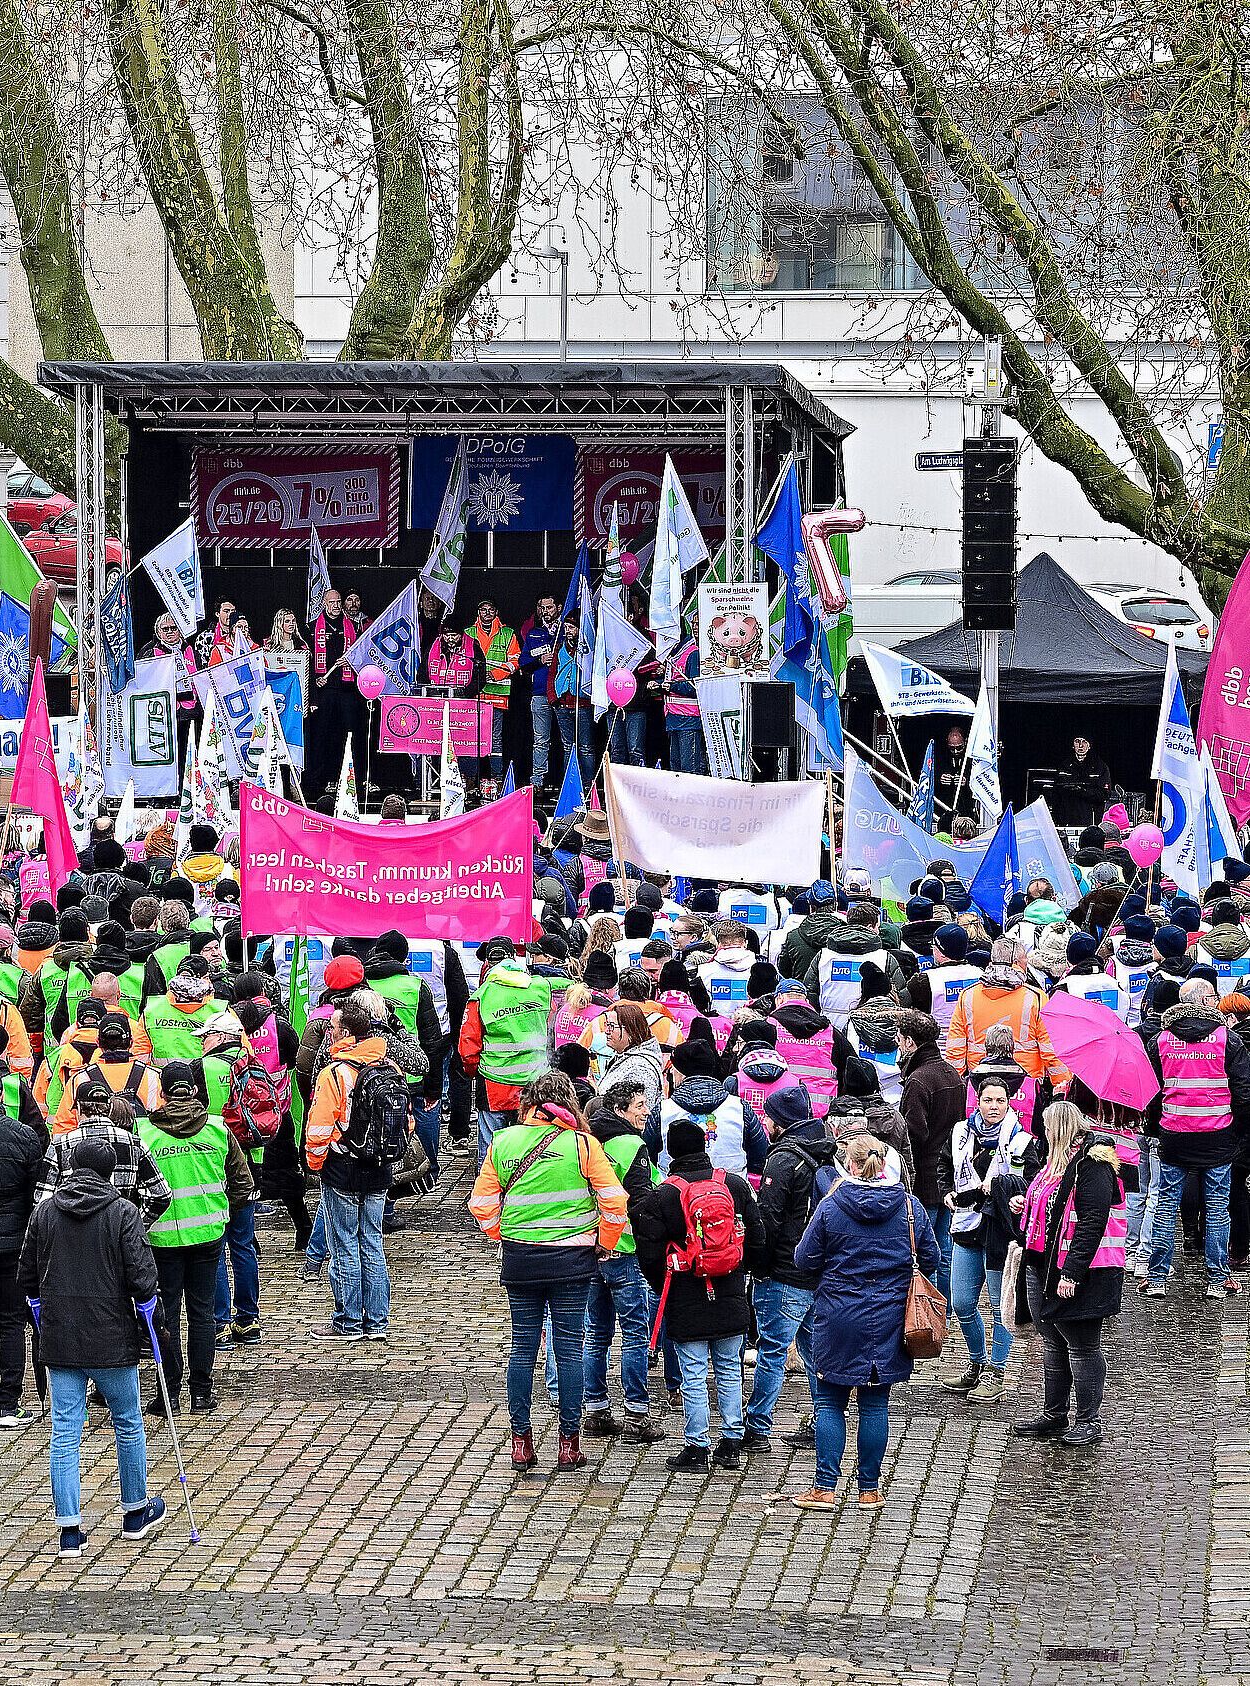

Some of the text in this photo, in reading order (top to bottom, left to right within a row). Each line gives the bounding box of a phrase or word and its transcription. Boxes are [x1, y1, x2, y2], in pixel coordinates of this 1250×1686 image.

[223, 458, 244, 468] dbb
[608, 458, 630, 468] dbb
[920, 455, 931, 467] Am
[344, 478, 366, 490] 300
[233, 486, 261, 496] dbb.de
[345, 491, 369, 503] Euro
[619, 486, 647, 496] dbb.de
[214, 500, 282, 527] 25/26
[603, 500, 661, 527] 25/2
[706, 587, 760, 596] Wir sind nicht die
[710, 596, 754, 604] Sparschweine
[717, 604, 728, 612] der
[318, 628, 327, 649] dbb
[367, 648, 410, 697] Gewerkscha
[1222, 666, 1244, 705] dbb
[1164, 726, 1196, 745] DEUTS
[1166, 1051, 1217, 1061] www.dbb.de
[501, 1156, 521, 1169] VDS
